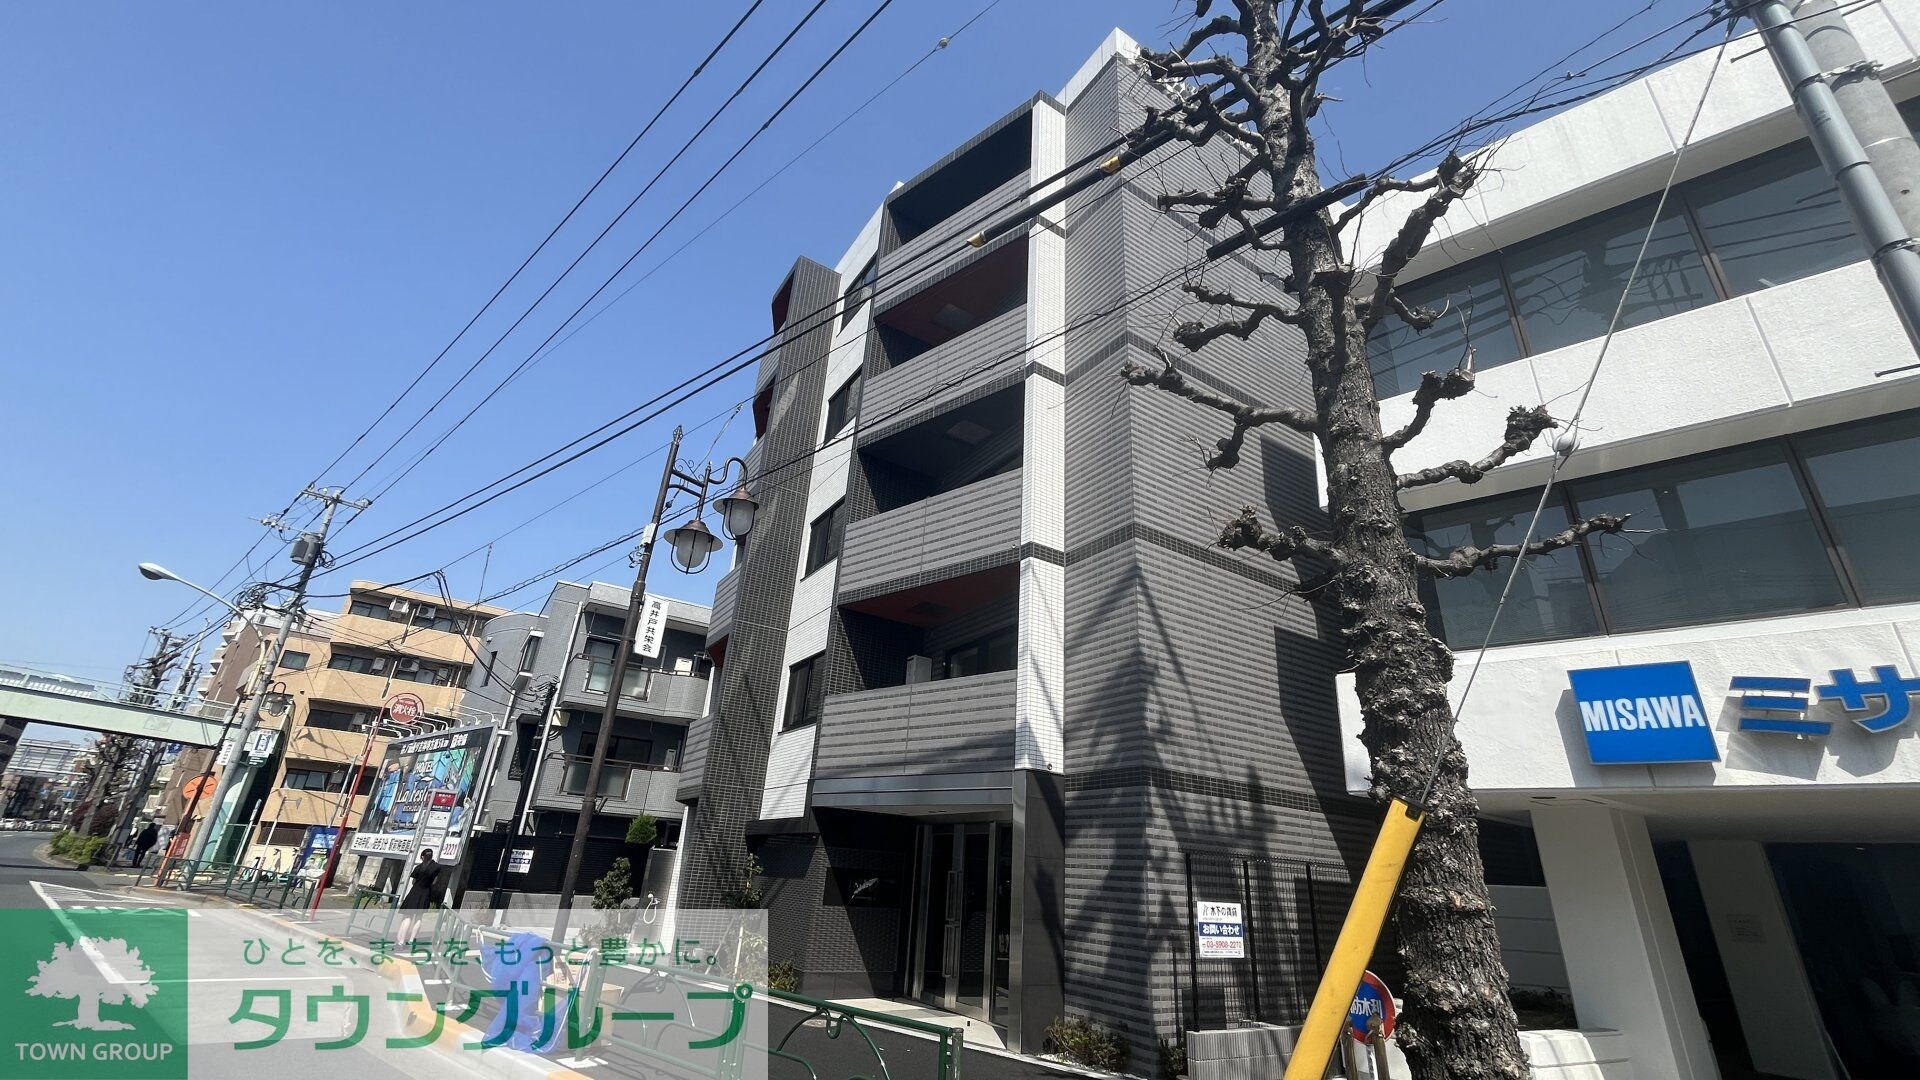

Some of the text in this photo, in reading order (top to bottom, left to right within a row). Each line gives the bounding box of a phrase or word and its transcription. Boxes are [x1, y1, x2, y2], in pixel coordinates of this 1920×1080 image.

[642, 600, 662, 653] 高井戸共栄会
[392, 703, 417, 717] 消火栓
[1579, 694, 1706, 733] MISAWA
[1727, 664, 1920, 736] ミサ
[1202, 924, 1240, 935] お問い合わせ
